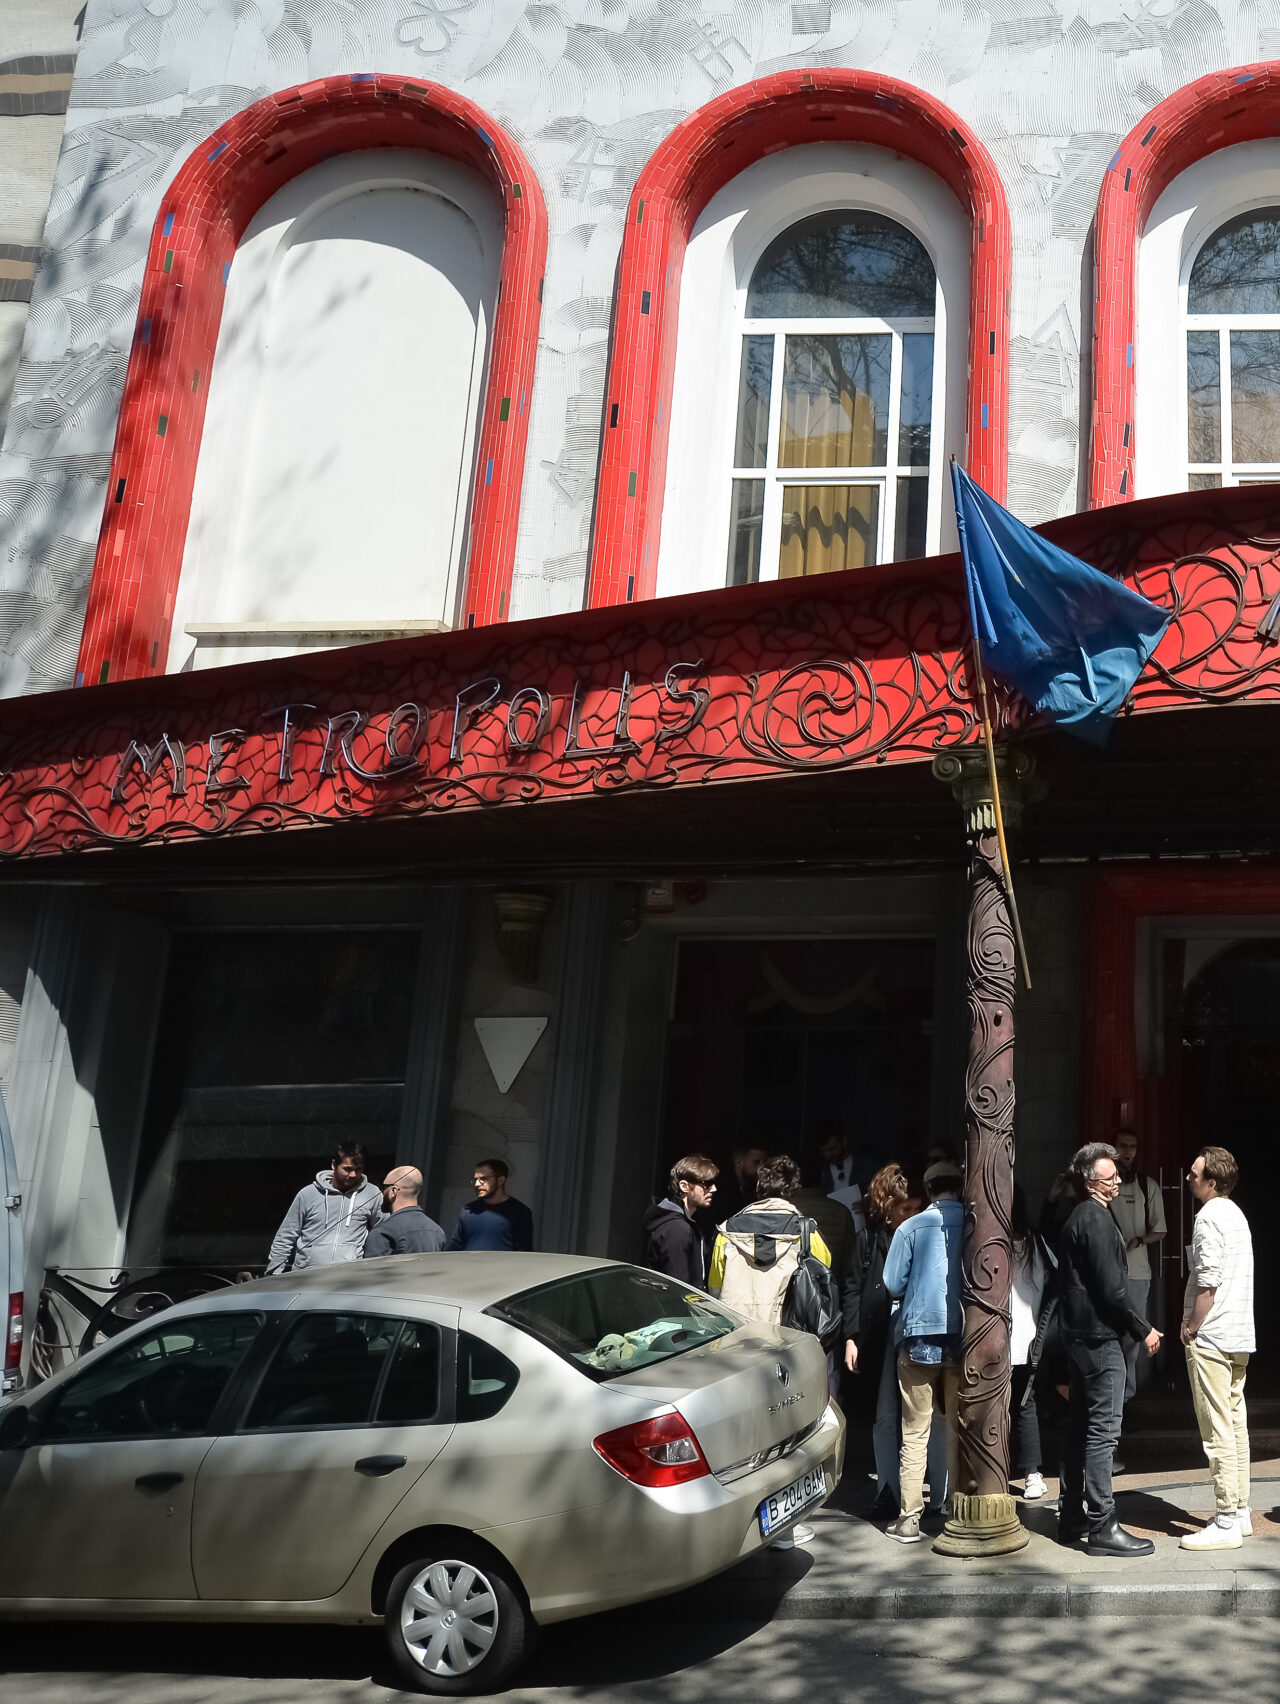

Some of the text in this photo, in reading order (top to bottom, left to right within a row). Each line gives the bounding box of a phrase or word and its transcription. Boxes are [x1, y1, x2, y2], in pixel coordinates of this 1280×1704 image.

[111, 658, 711, 801] METROPOLIS
[768, 1497, 779, 1521] B
[782, 1481, 803, 1513] 204
[804, 1464, 825, 1496] GAM
